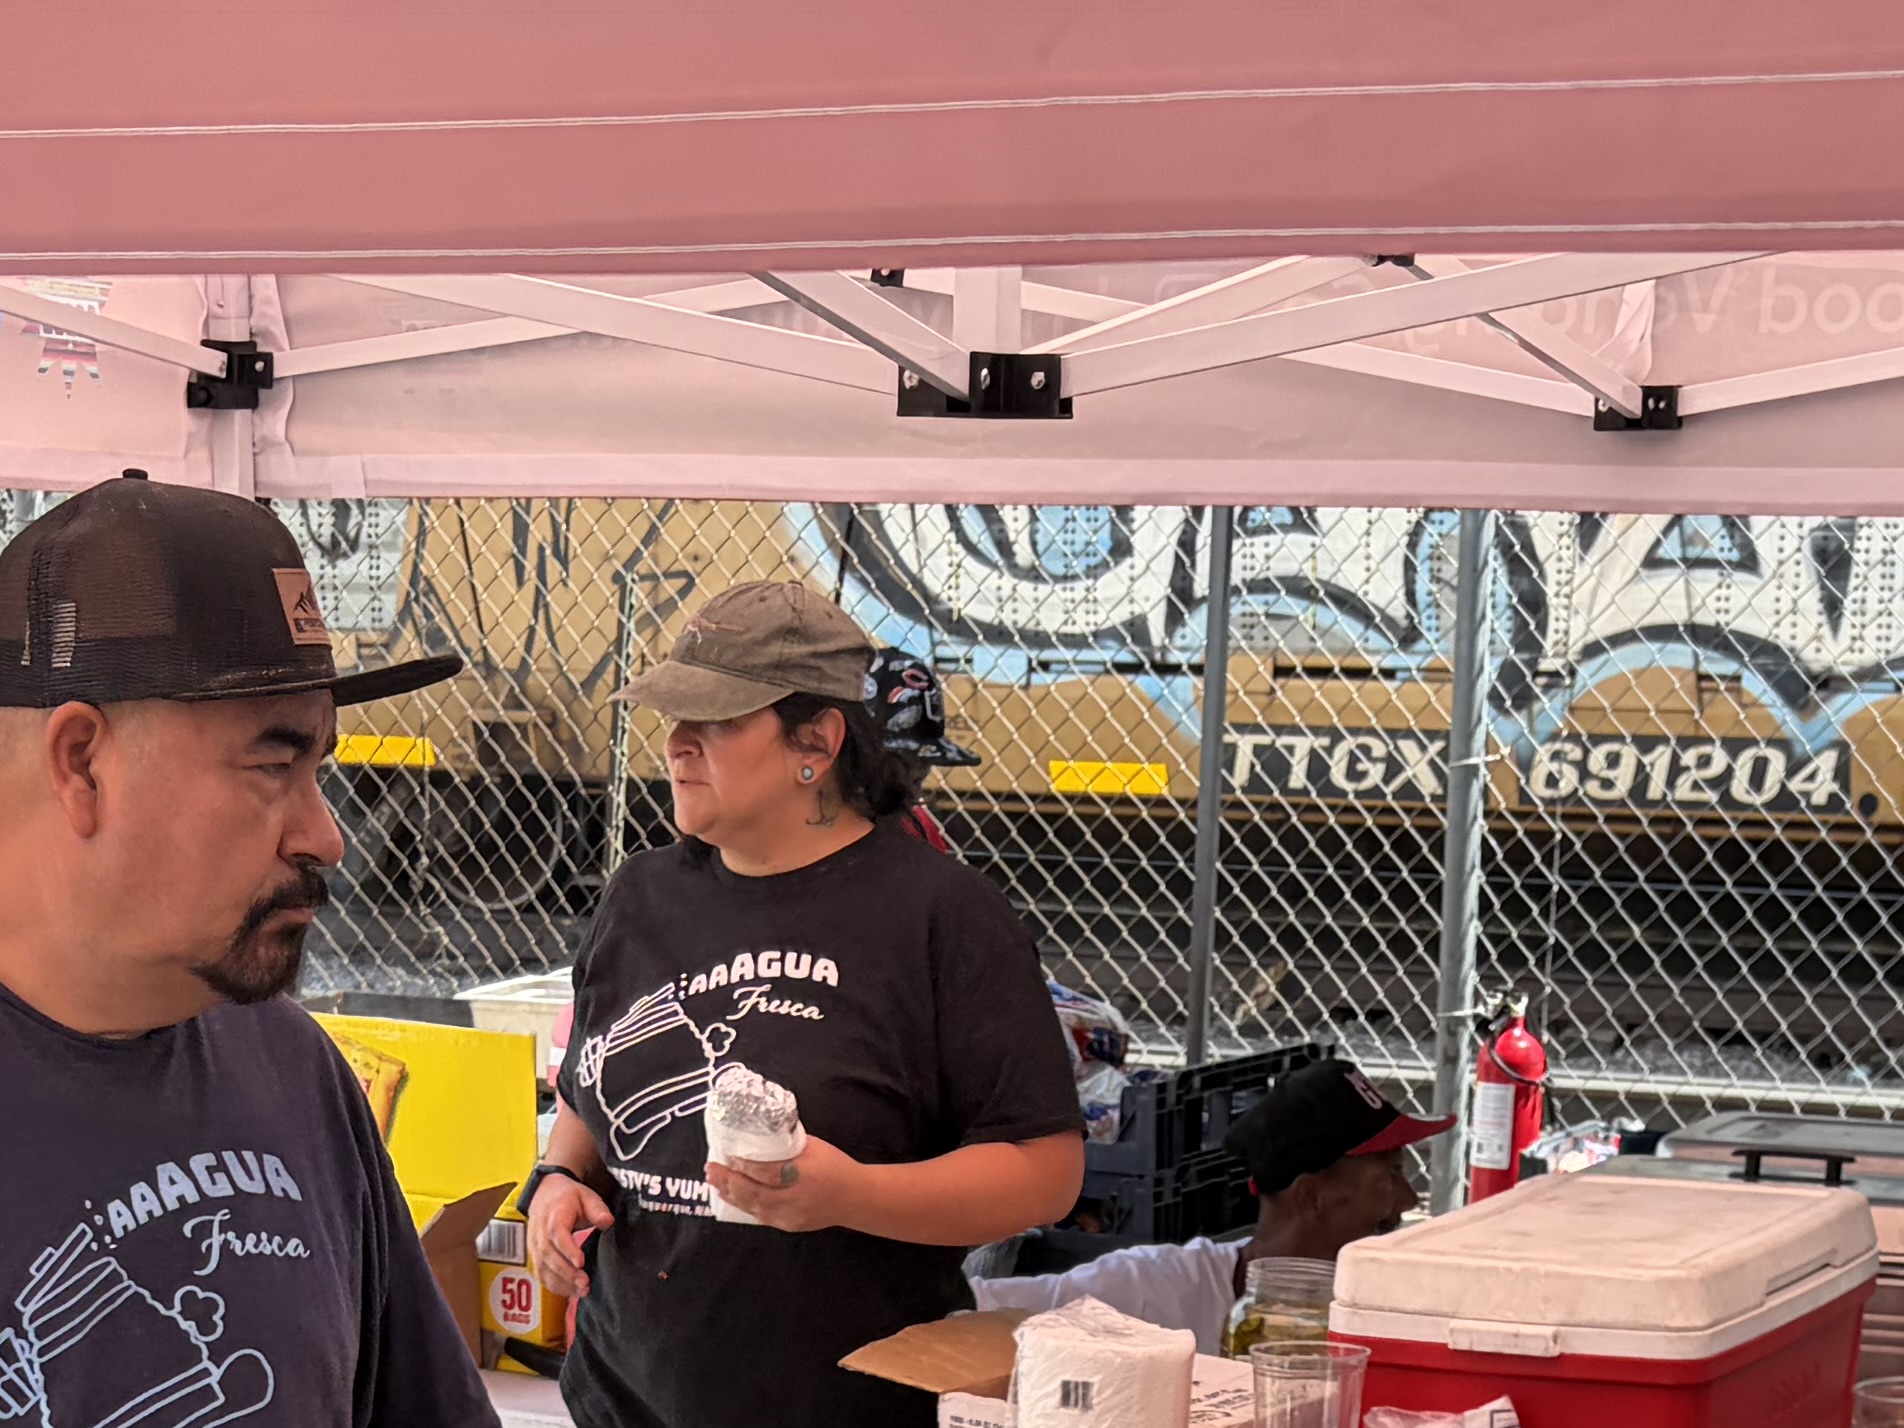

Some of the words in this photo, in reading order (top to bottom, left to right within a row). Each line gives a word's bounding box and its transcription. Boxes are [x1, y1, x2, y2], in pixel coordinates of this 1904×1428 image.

[1221, 731, 1449, 797] TTGX
[1528, 740, 1843, 808] 691204
[687, 951, 840, 997] AAAGUA
[725, 983, 825, 1021] Fresca
[106, 1149, 303, 1240] AAAGUA
[182, 1208, 311, 1277] Fresca
[501, 1276, 533, 1313] 50
